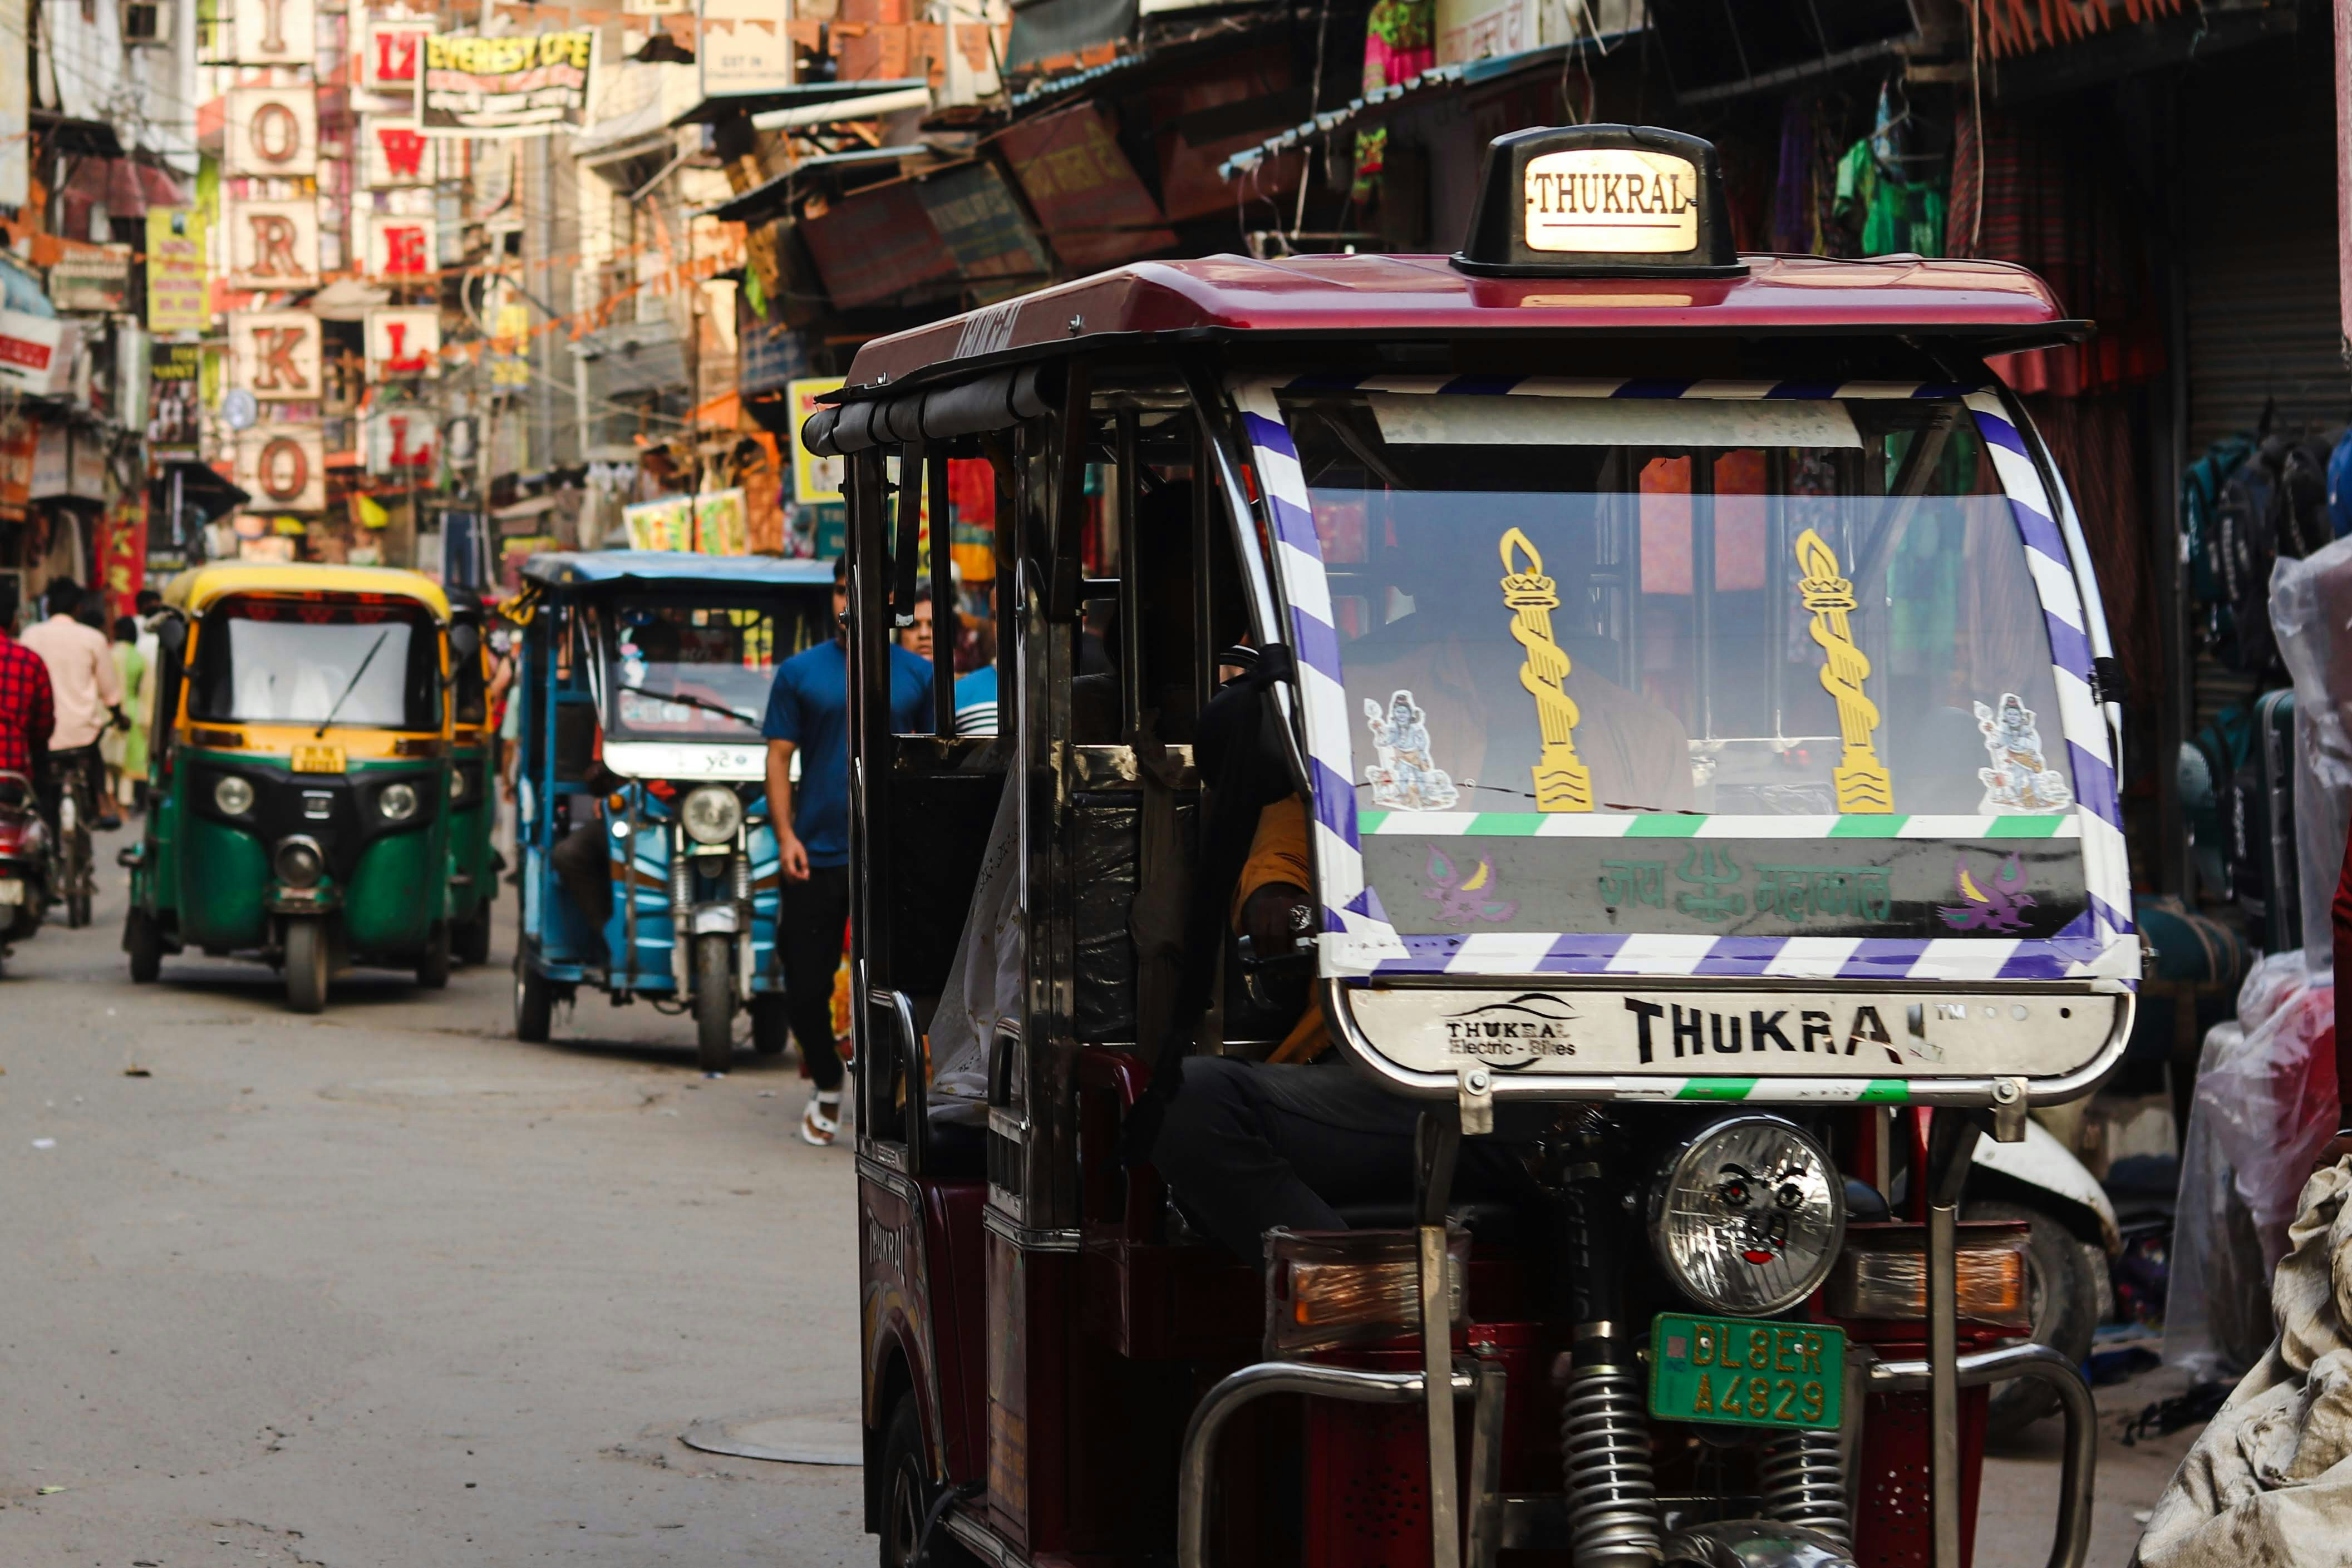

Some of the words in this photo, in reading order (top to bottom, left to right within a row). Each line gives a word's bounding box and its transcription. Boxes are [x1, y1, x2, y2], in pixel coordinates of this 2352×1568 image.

[1534, 173, 1686, 214] THUKRAL
[1598, 859, 1666, 909] जय
[1754, 864, 1893, 922] महाकाल
[1446, 1022, 1570, 1038] THUKRAL
[1449, 1039, 1513, 1054] Electric
[1529, 1039, 1577, 1056] Bikes
[1625, 997, 1946, 1065] THUKRAL
[867, 1205, 906, 1287] THUKRAL
[1692, 1323, 1823, 1374] DL8ER
[1694, 1373, 1824, 1422] A4829
